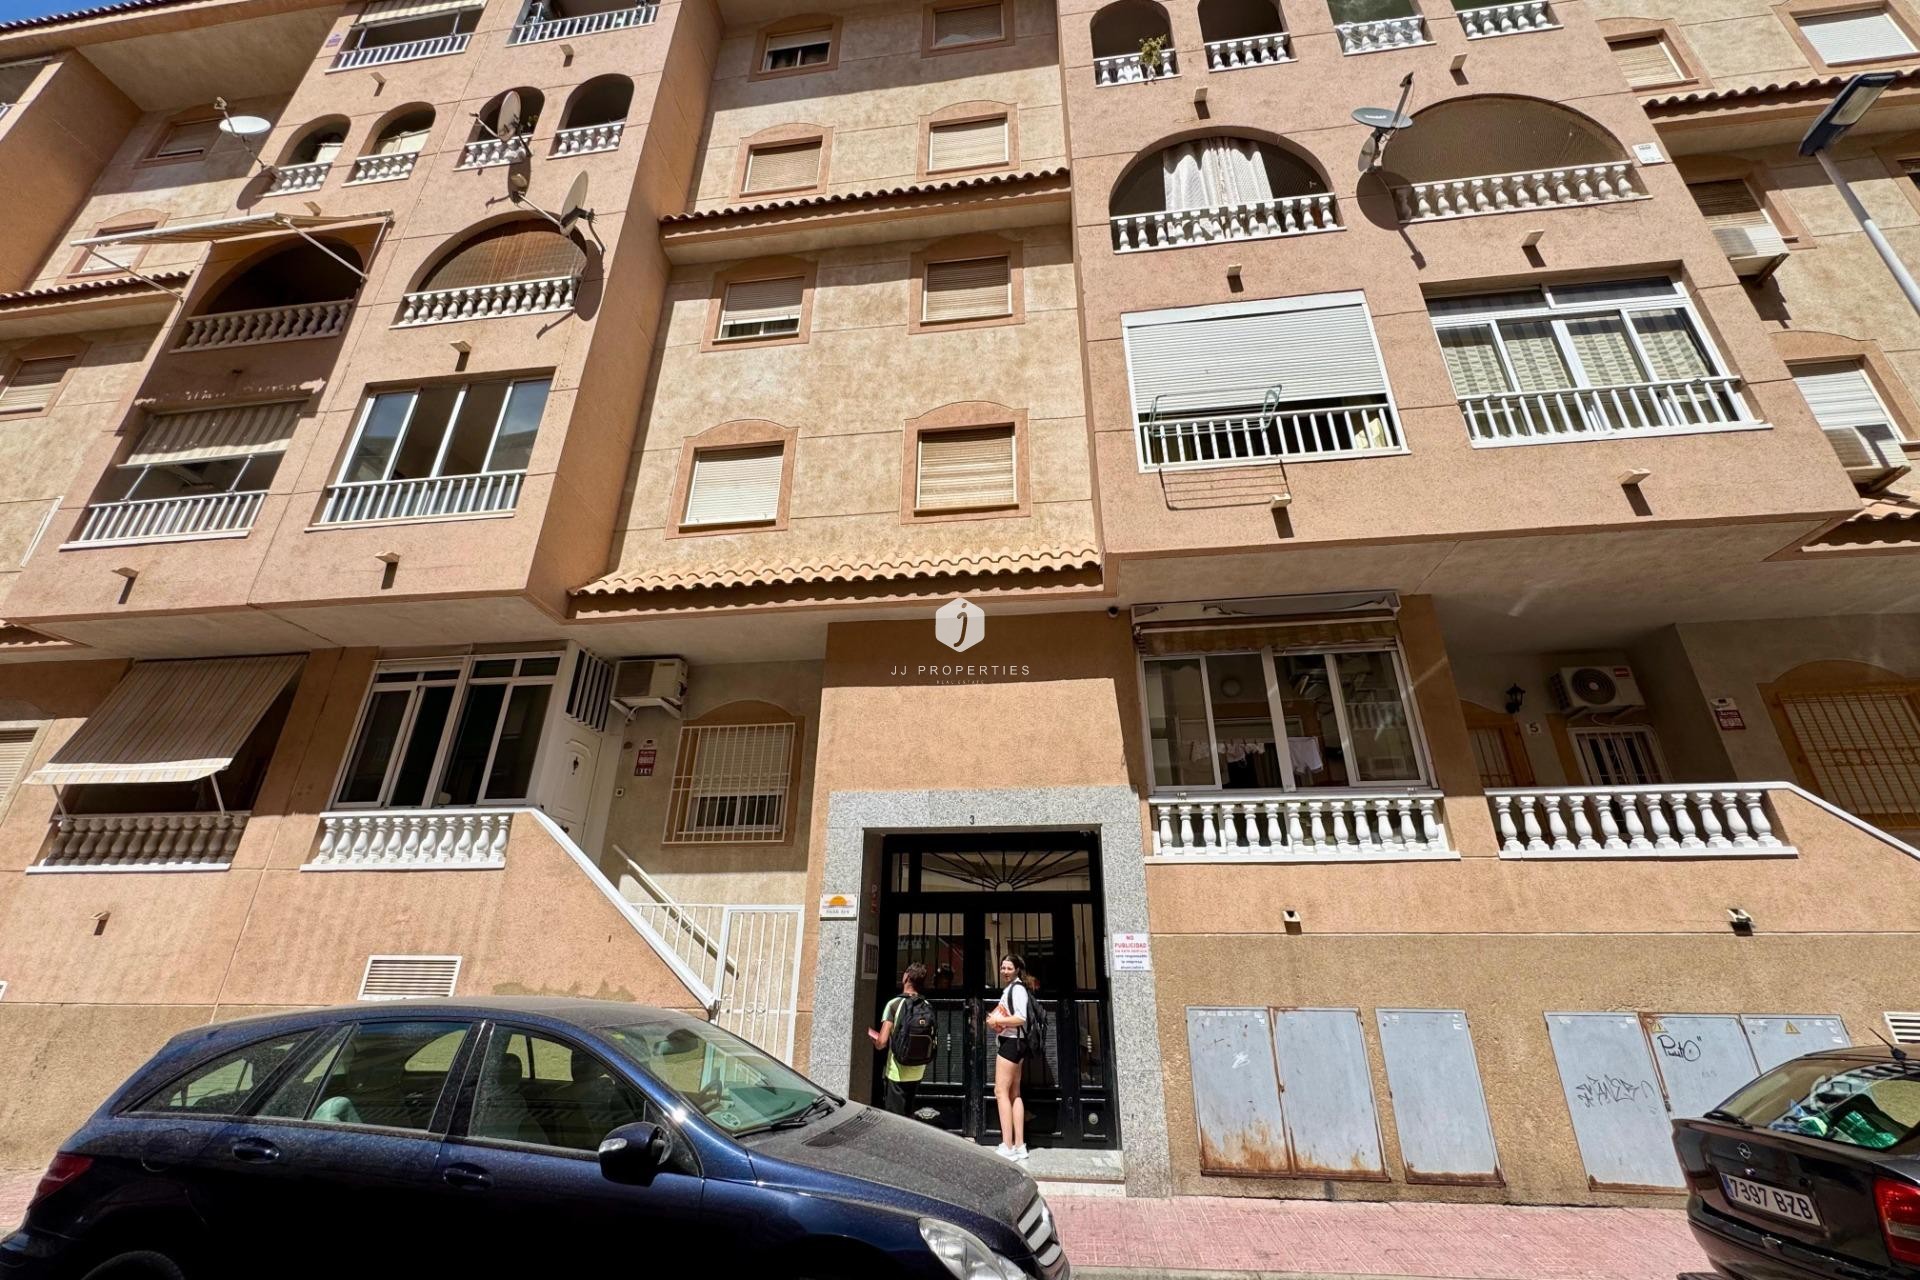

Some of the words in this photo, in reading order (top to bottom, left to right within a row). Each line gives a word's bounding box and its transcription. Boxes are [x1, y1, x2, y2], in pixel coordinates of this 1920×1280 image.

[1529, 721, 1539, 733] 5
[969, 815, 975, 825] 3
[1729, 1178, 1768, 1207] 7397
[1772, 1190, 1813, 1220] BZB
